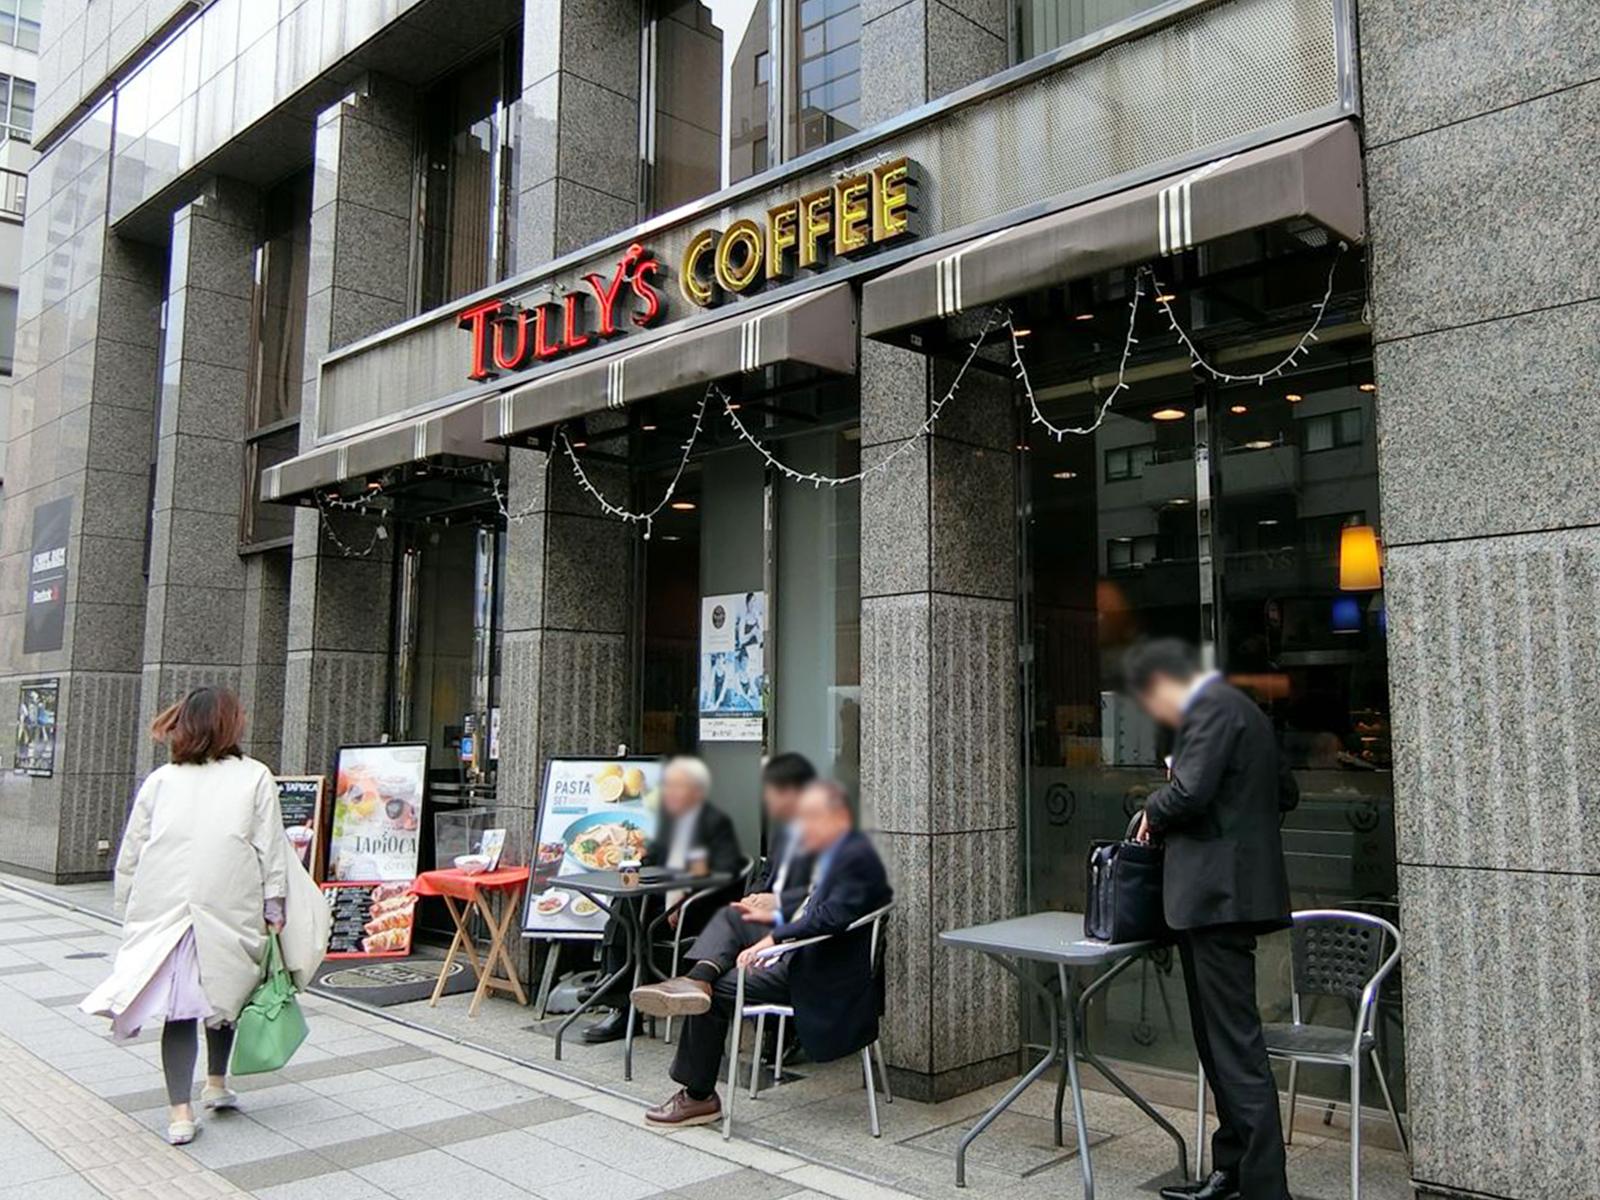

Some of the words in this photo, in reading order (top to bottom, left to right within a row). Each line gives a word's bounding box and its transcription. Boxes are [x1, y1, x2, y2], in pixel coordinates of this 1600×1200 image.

[457, 243, 663, 381] TULLY'S
[679, 157, 919, 308] COFFEE
[554, 780, 591, 795] PASTA
[553, 796, 567, 806] SET
